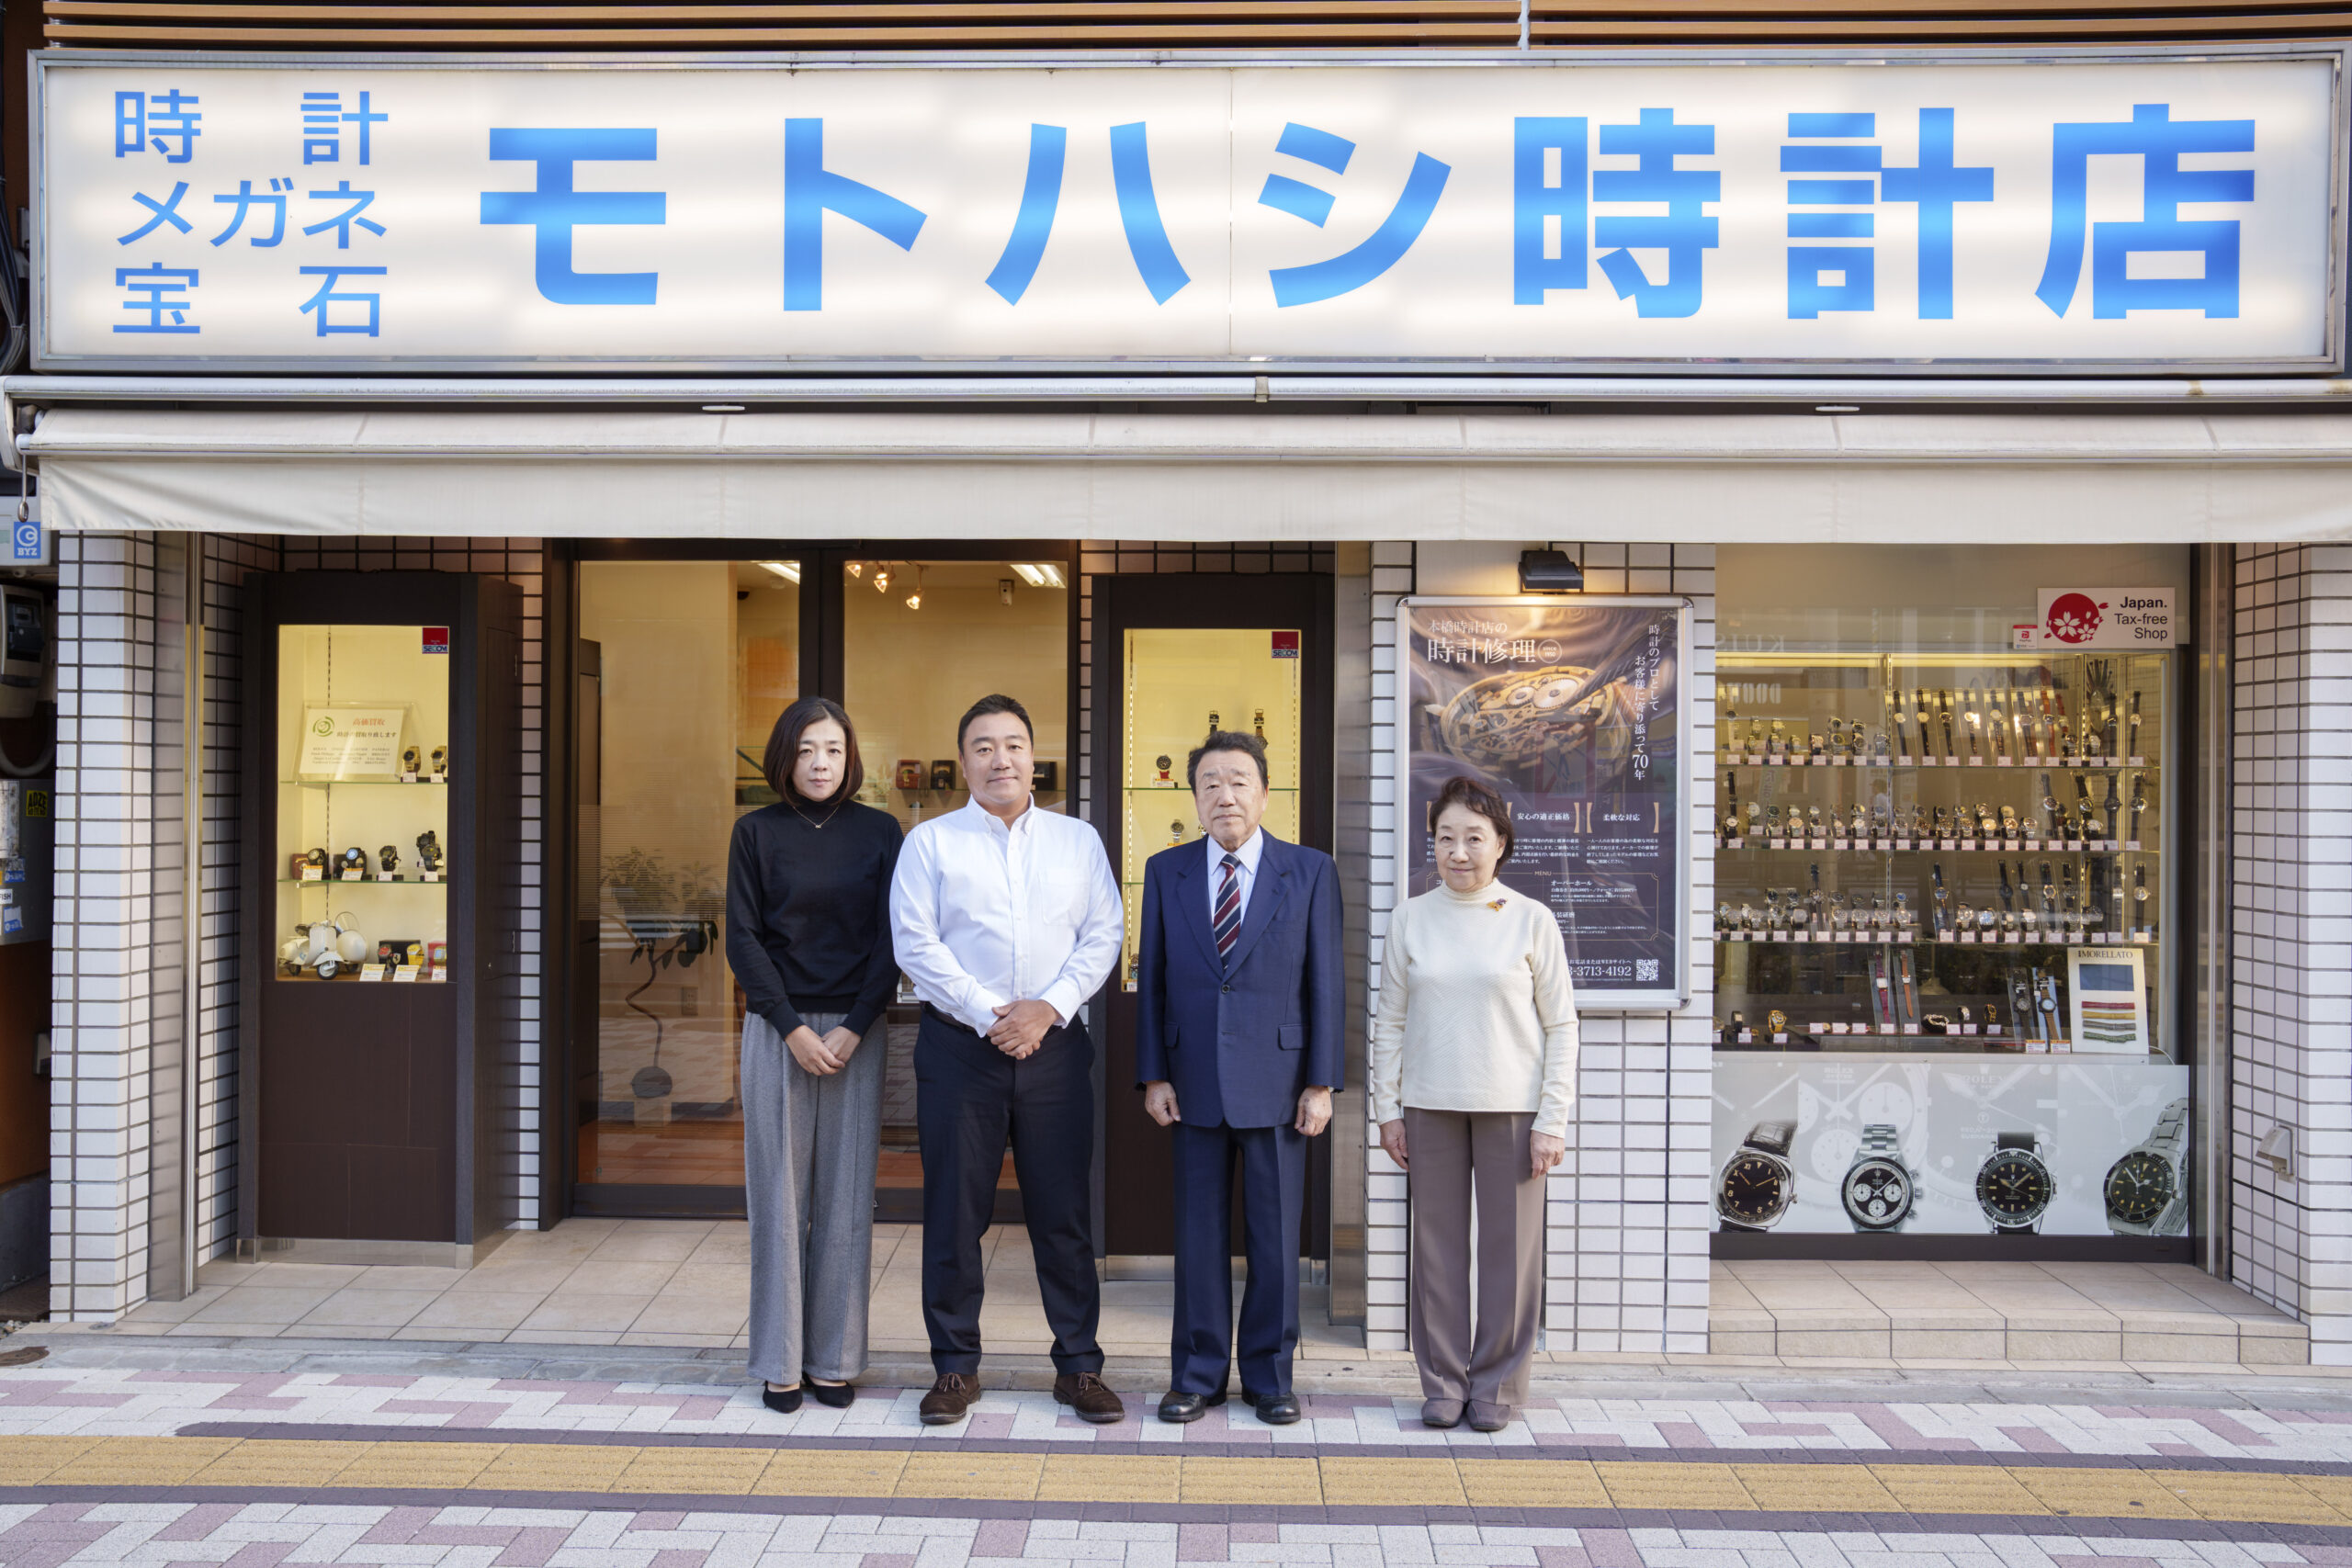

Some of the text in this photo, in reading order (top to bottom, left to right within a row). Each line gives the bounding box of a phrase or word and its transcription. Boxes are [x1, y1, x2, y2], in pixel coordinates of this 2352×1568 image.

[117, 177, 388, 250] メガネ
[480, 103, 2256, 321] モトハシ時計店
[17, 547, 38, 557] BYZ
[2120, 596, 2168, 610] Japan.
[2114, 613, 2168, 625] Tax-free
[1428, 620, 1508, 635] 本橋時計店の
[2134, 627, 2168, 641] Shop
[1428, 636, 1536, 664] 時計修理
[1648, 624, 1660, 712] 時計のプロとして
[1633, 655, 1649, 781] お客様に寄り添って70年
[1517, 812, 1570, 821] 安心の適正価格
[1603, 813, 1641, 821] 柔軟な対応
[2080, 950, 2133, 959] MORELLATO
